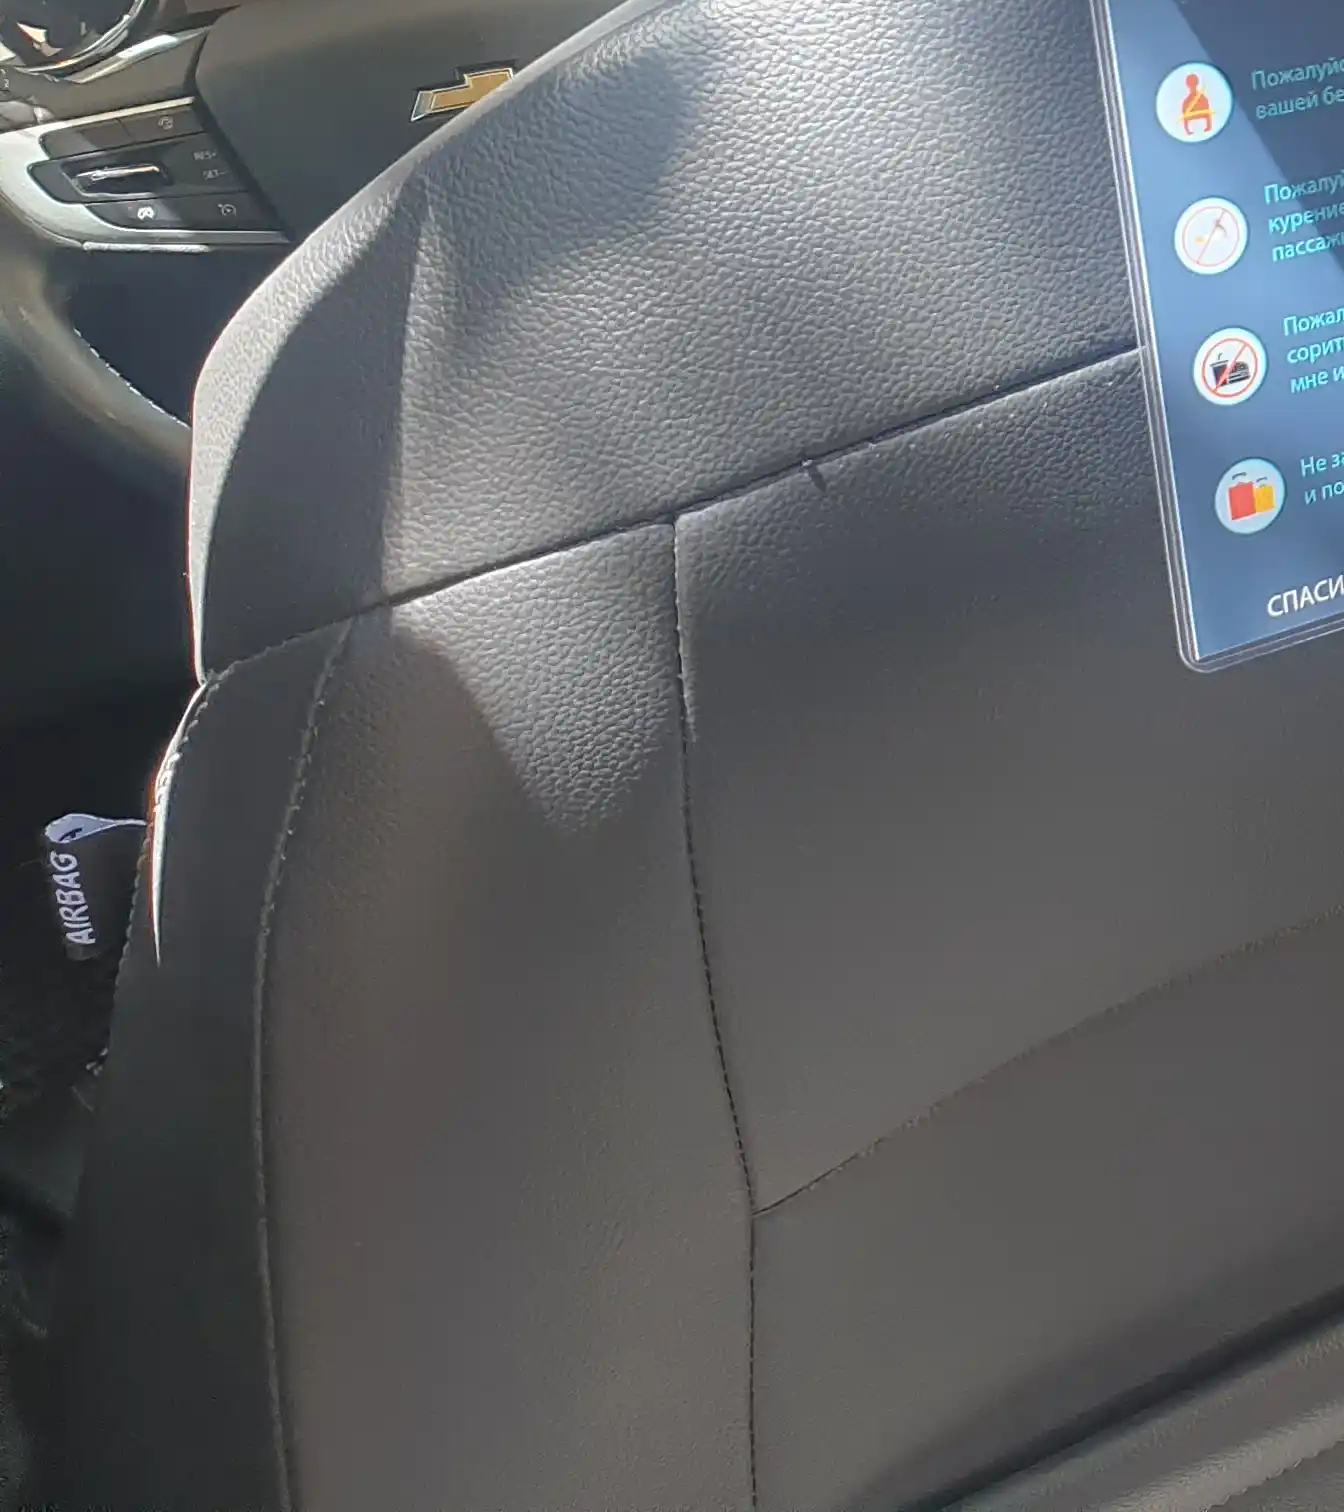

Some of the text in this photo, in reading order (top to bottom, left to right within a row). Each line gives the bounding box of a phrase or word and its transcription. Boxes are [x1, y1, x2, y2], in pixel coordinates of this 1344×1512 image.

[1256, 92, 1318, 119] вашей
[1291, 372, 1328, 394] мне
[1333, 365, 1344, 382] и
[1301, 457, 1327, 477] Не
[1305, 489, 1316, 505] и
[50, 851, 95, 944] AIRBAG
